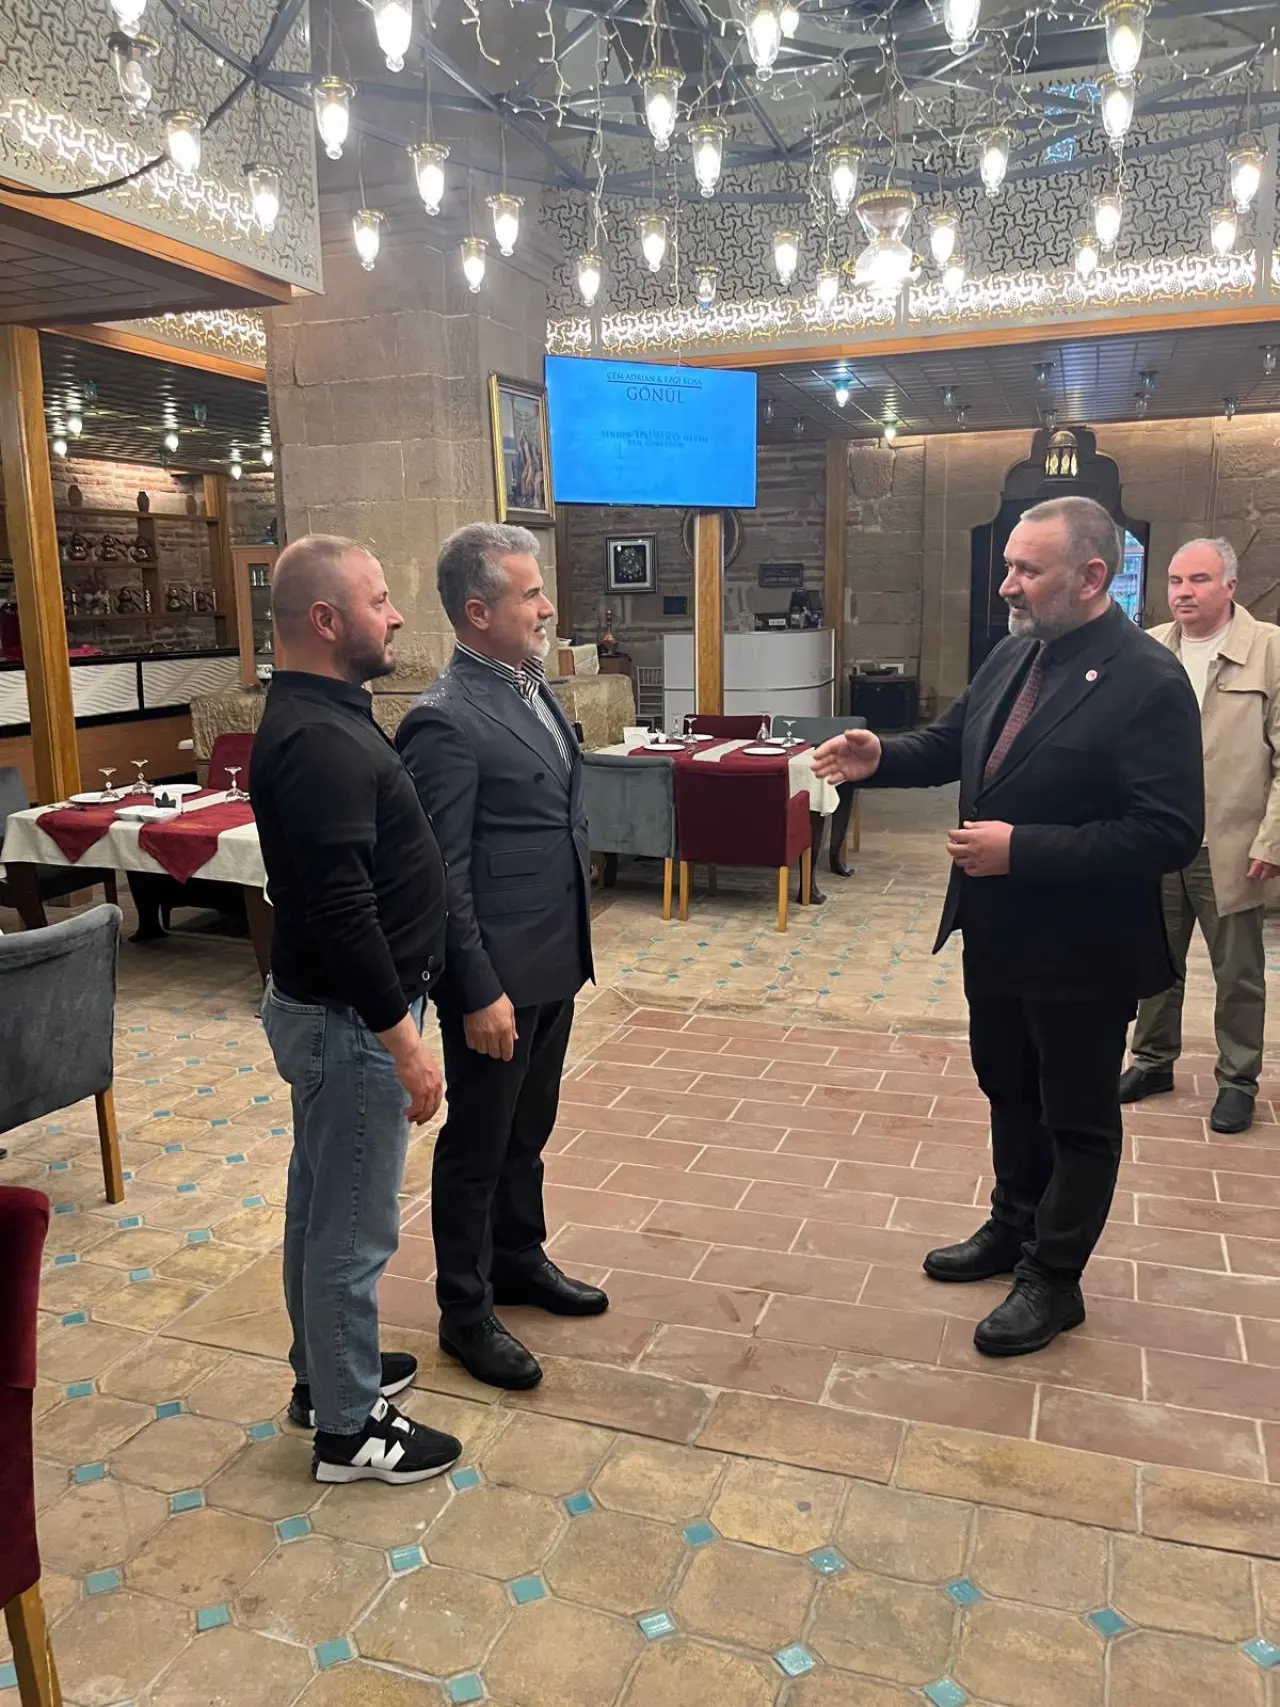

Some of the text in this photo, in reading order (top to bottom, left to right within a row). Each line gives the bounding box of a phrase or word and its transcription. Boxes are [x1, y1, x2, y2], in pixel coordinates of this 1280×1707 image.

[606, 372, 624, 380] CEM
[625, 373, 656, 382] ADRIAN
[626, 385, 685, 404] GÖNÜL
